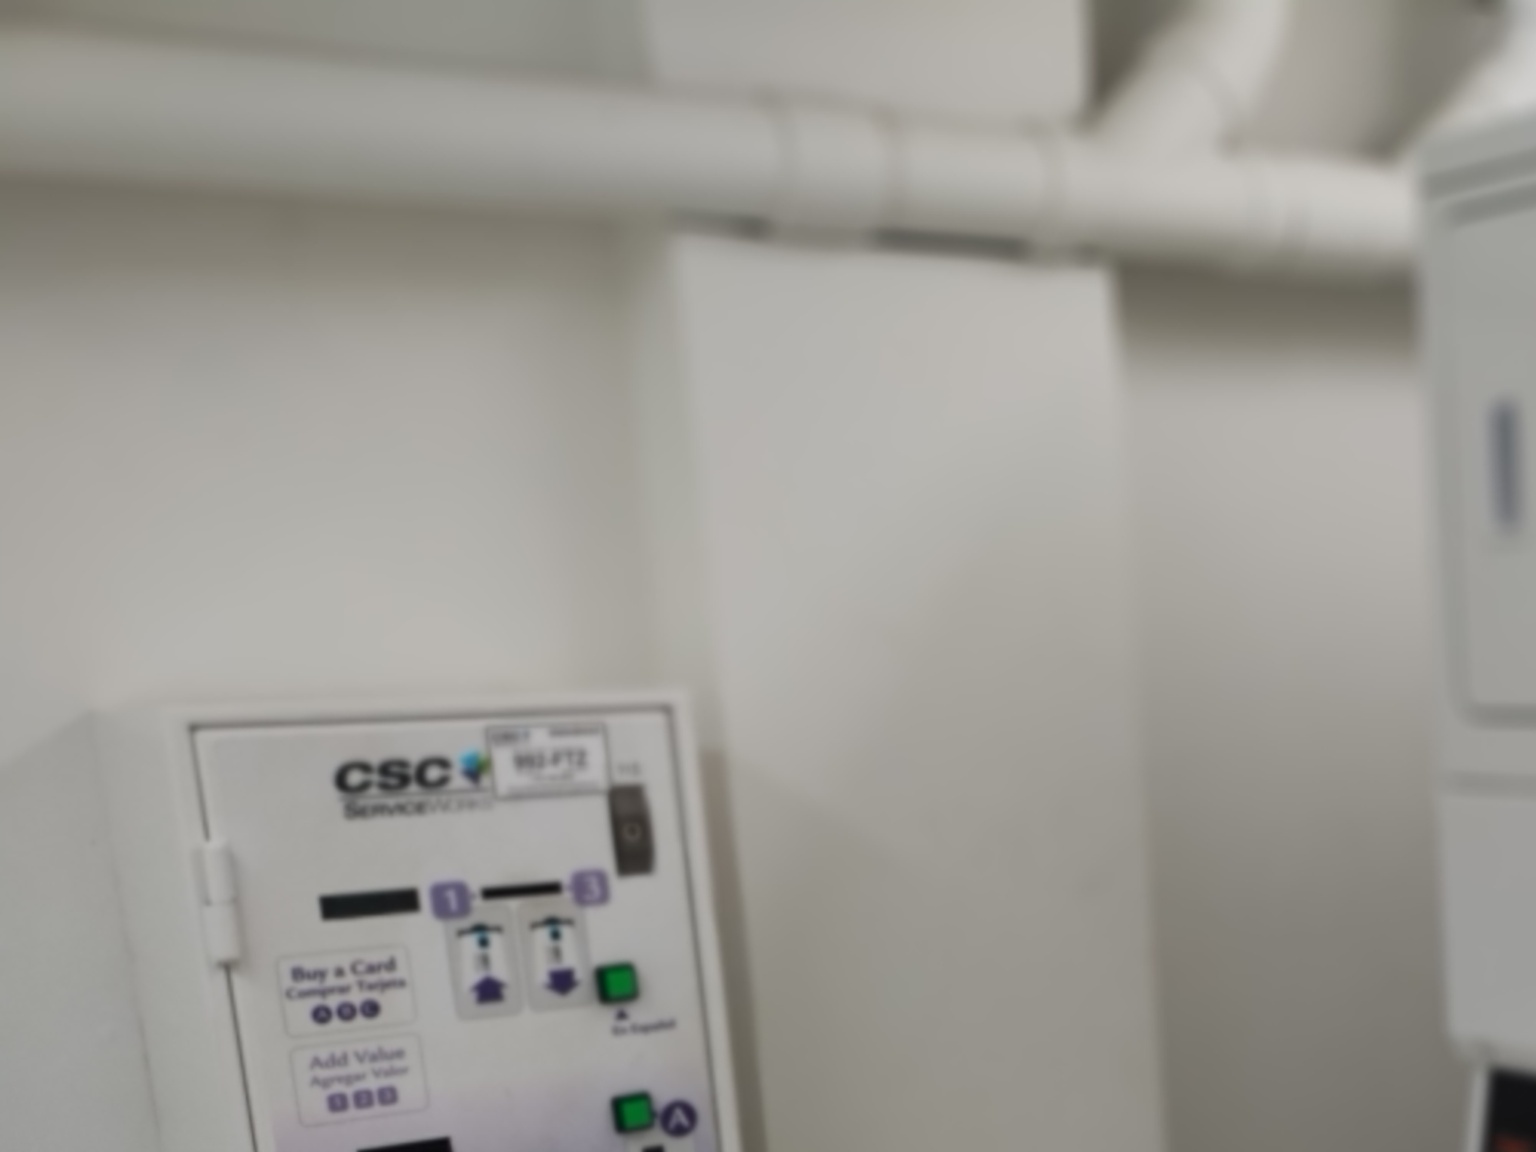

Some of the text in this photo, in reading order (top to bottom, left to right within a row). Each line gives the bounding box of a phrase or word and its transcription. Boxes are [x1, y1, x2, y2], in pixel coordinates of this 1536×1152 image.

[335, 757, 452, 795] CSC
[587, 873, 602, 896] 3
[445, 888, 458, 913] 1
[291, 955, 397, 984] Buy a Card
[310, 1046, 406, 1071] Add Value
[667, 1105, 690, 1130] A
